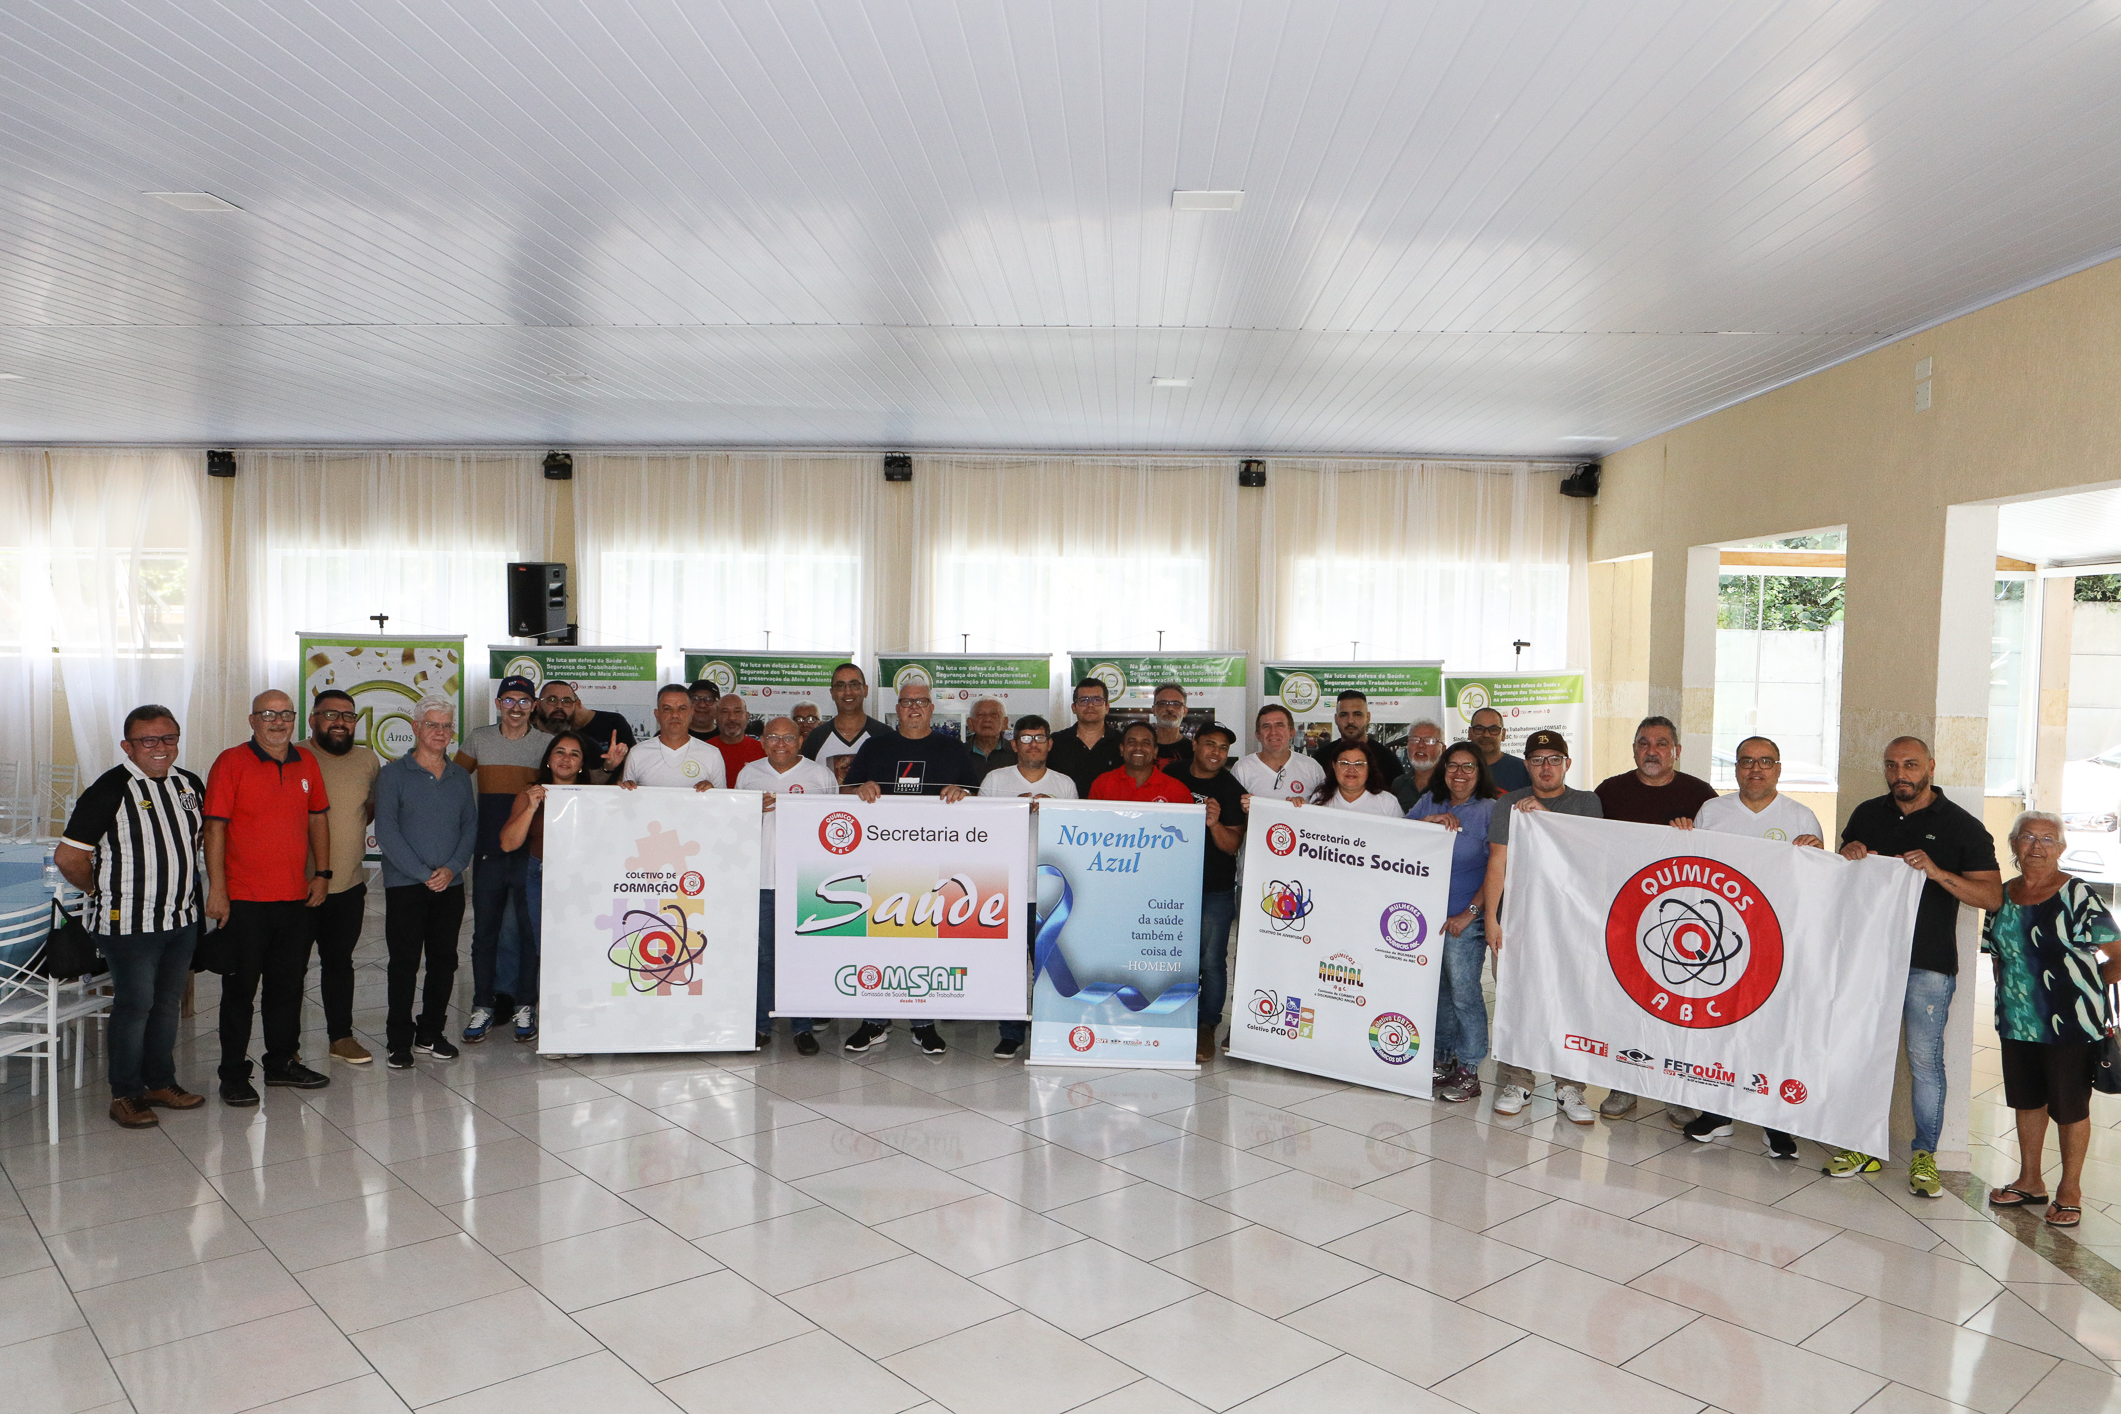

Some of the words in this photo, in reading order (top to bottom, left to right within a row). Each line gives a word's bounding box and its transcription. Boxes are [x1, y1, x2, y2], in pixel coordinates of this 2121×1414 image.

[1286, 681, 1312, 698] 40
[1462, 692, 1484, 708] 40
[387, 732, 413, 742] Anos
[826, 812, 855, 824] QUÍMICOS
[867, 825, 959, 842] Secretaria
[966, 827, 988, 842] de
[1057, 824, 1174, 849] Novembro
[1300, 829, 1350, 846] Secretaria
[1354, 838, 1366, 847] de
[1087, 851, 1141, 873] Azul
[1299, 843, 1365, 867] Políticas
[1370, 854, 1429, 877] Sociais
[614, 881, 678, 895] FORMAÇÃO
[1641, 860, 1754, 912] QUÍMICOS
[795, 866, 1006, 934] Saúde
[1148, 899, 1185, 910] Cuidar
[1389, 904, 1421, 917] MULHERES
[1138, 915, 1151, 925] da
[1154, 914, 1184, 925] saúde
[1131, 930, 1174, 941] também
[1177, 931, 1183, 941] é
[1140, 947, 1167, 956] coisa
[1169, 947, 1182, 957] de
[1330, 952, 1355, 965] QUÍMICOS
[1128, 960, 1182, 972] HOMEM!
[1319, 961, 1364, 987] RACIAL
[835, 965, 967, 997] COMSAT
[1247, 1024, 1269, 1032] Coletivo
[1271, 1026, 1286, 1036] PCD
[1566, 1036, 1603, 1054] CUT
[1664, 1058, 1735, 1083] FETQUIM
